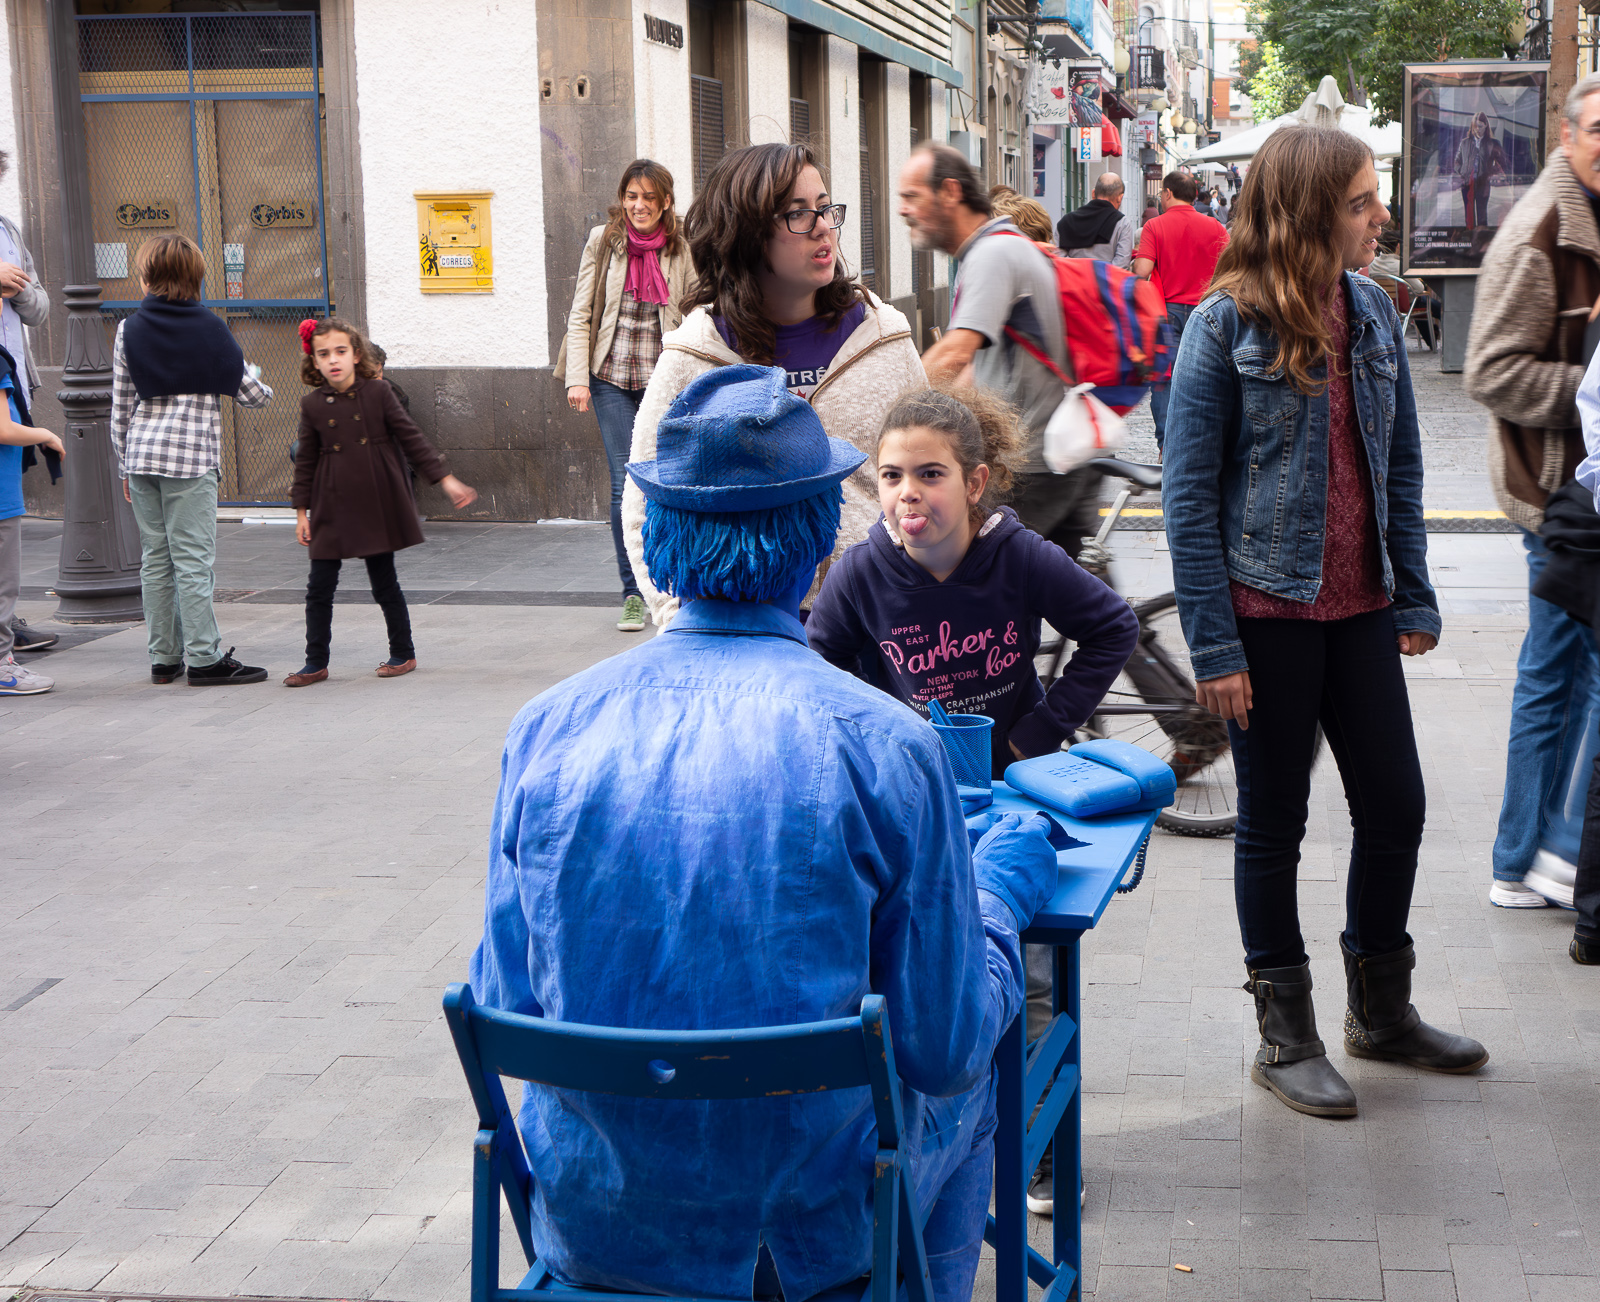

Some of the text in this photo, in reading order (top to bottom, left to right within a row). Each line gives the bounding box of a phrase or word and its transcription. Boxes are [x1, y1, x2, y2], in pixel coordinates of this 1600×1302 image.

[116, 203, 170, 226] Orbis
[250, 203, 305, 226] Orbis
[441, 257, 472, 265] CORREOS
[787, 366, 827, 385] TRÉ
[891, 624, 921, 635] UPPER
[906, 635, 930, 645] EAST
[880, 621, 1018, 674] Parker &
[926, 669, 979, 686] NEW YORK
[937, 682, 955, 691] THAT
[930, 691, 954, 701] SLEEPS
[946, 682, 1015, 709] CRAFTMANSHIP
[962, 703, 987, 714] 1993
